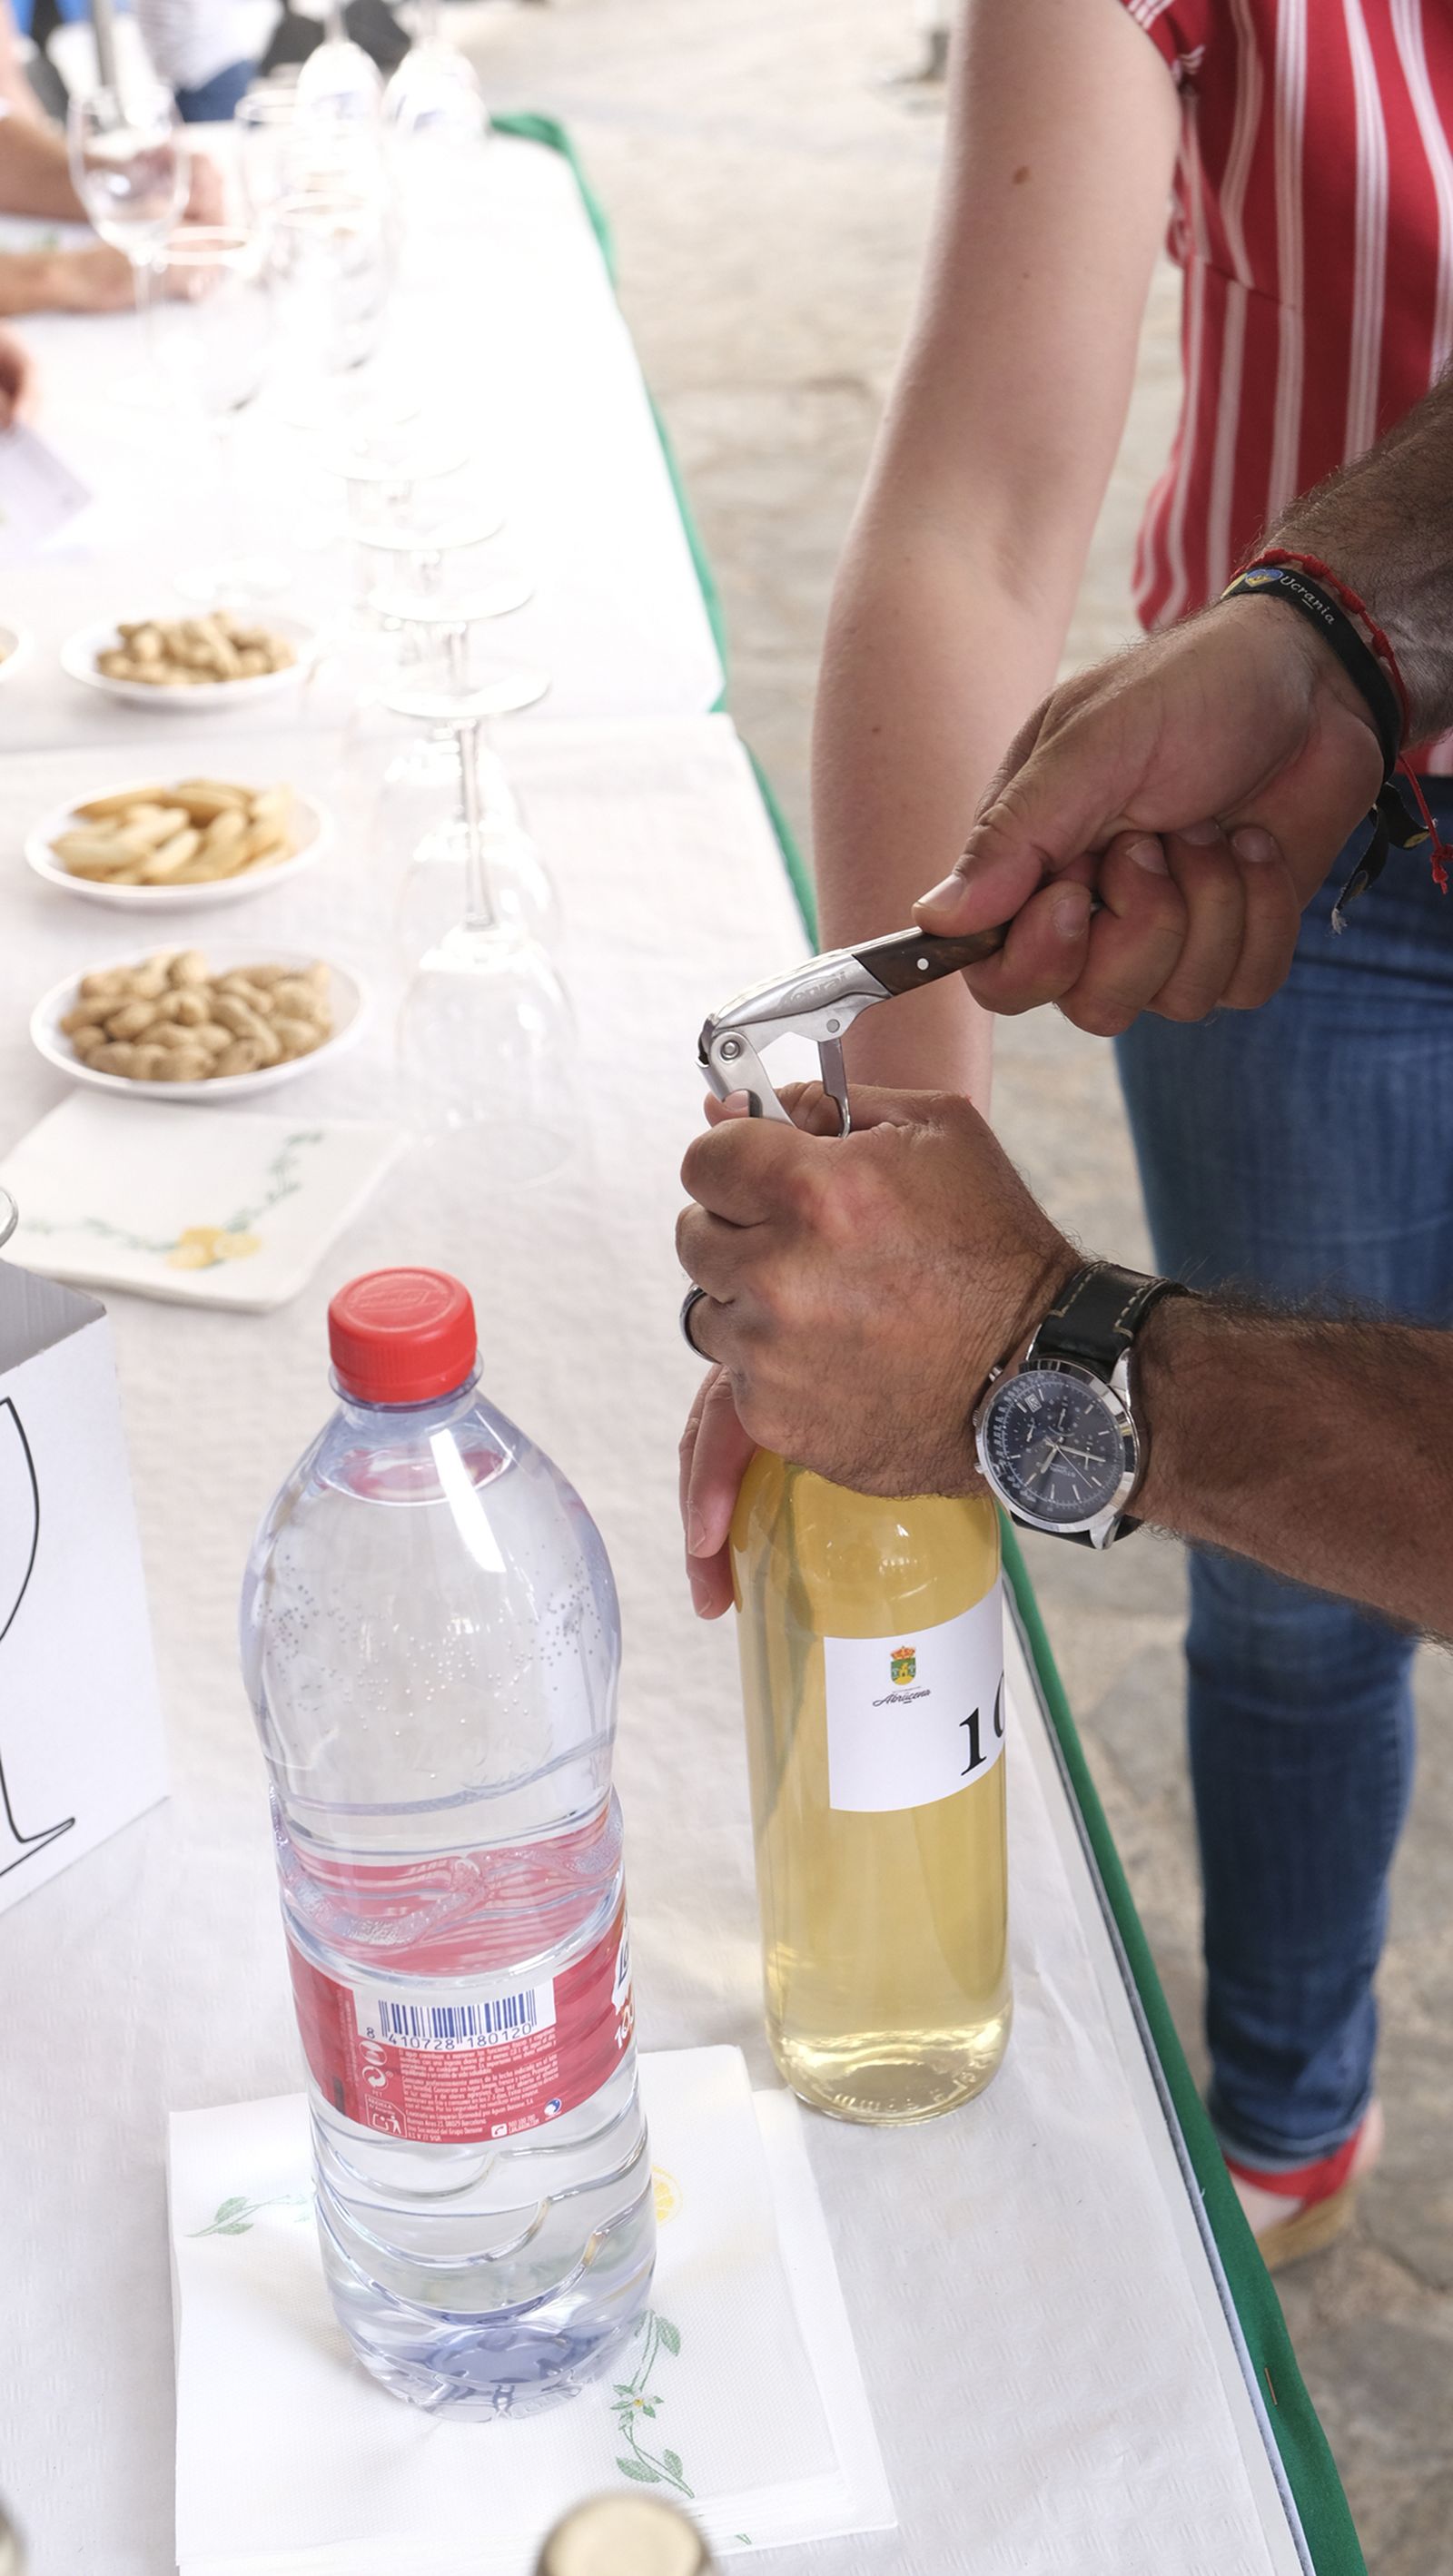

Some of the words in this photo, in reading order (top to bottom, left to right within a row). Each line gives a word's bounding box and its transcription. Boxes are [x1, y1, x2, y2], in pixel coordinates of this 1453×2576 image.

[1280, 576, 1336, 625] Ucrania
[873, 1689, 931, 1707] Abrucena
[366, 2027, 375, 2039] 8
[388, 2033, 455, 2050] 410728
[468, 2022, 532, 2048] 180120
